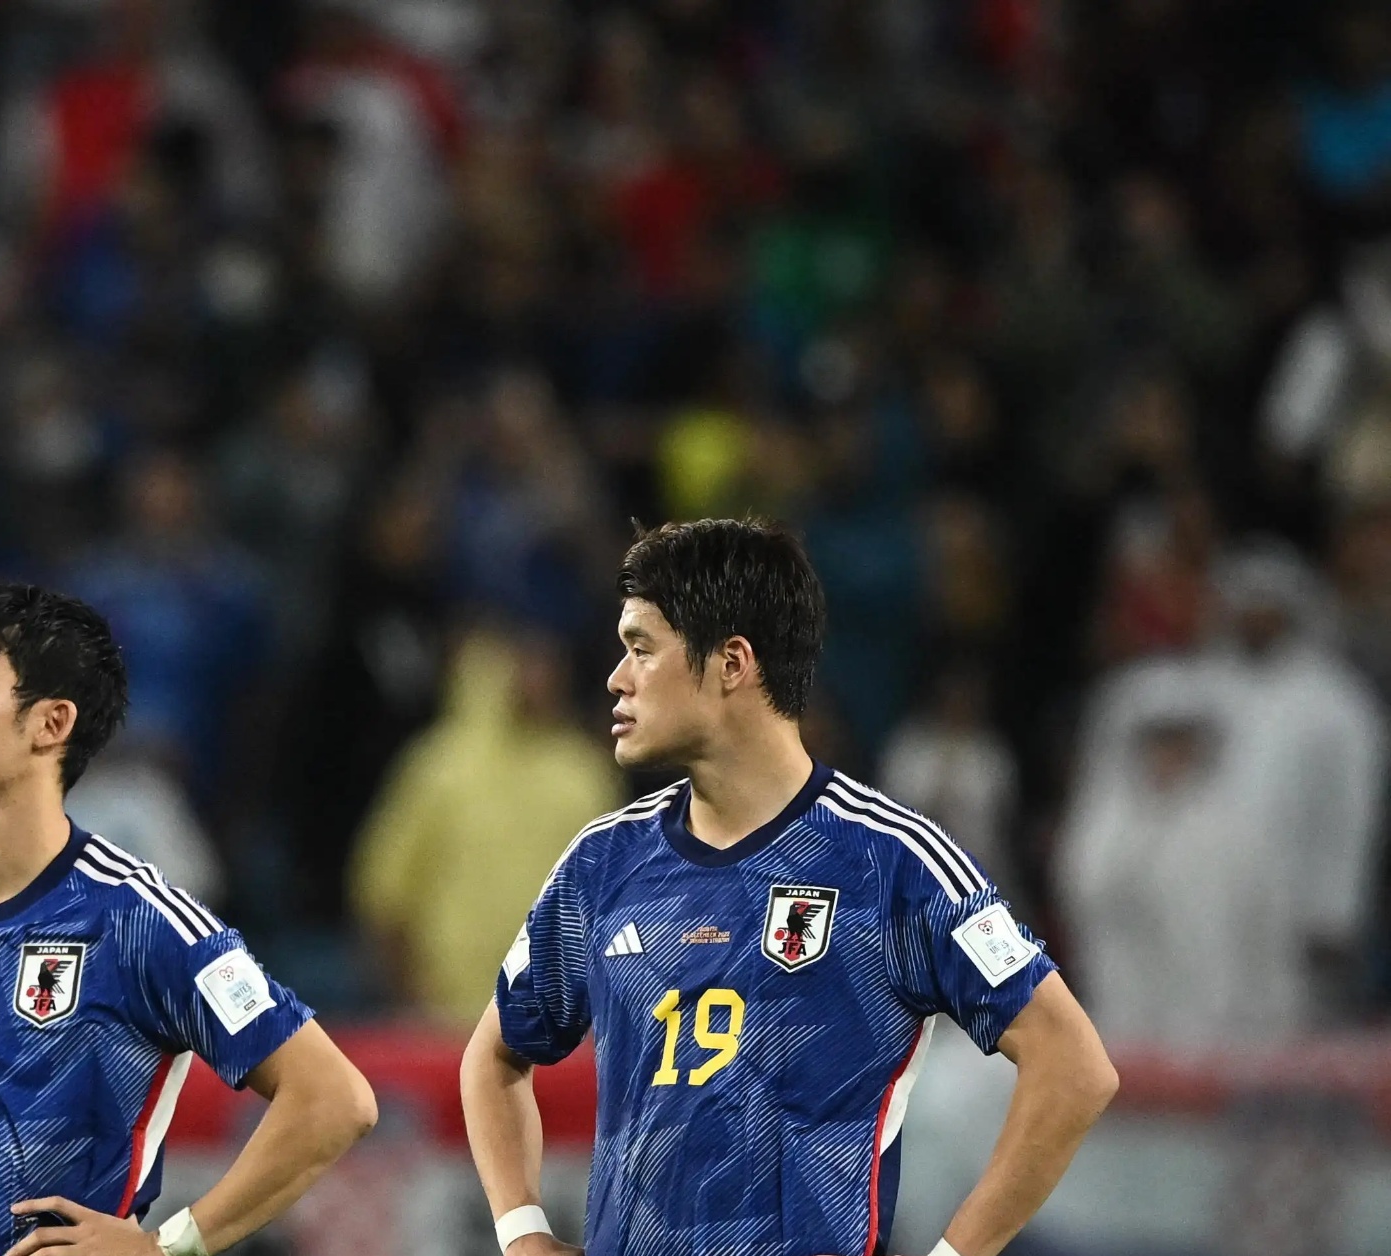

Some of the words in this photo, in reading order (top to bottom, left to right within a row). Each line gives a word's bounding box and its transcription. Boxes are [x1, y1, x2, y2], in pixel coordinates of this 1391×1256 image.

[786, 889, 820, 897] JAPAN
[36, 946, 69, 954] JAPAN
[778, 942, 807, 956] JFA
[29, 998, 56, 1011] JFA
[651, 988, 745, 1087] 19
